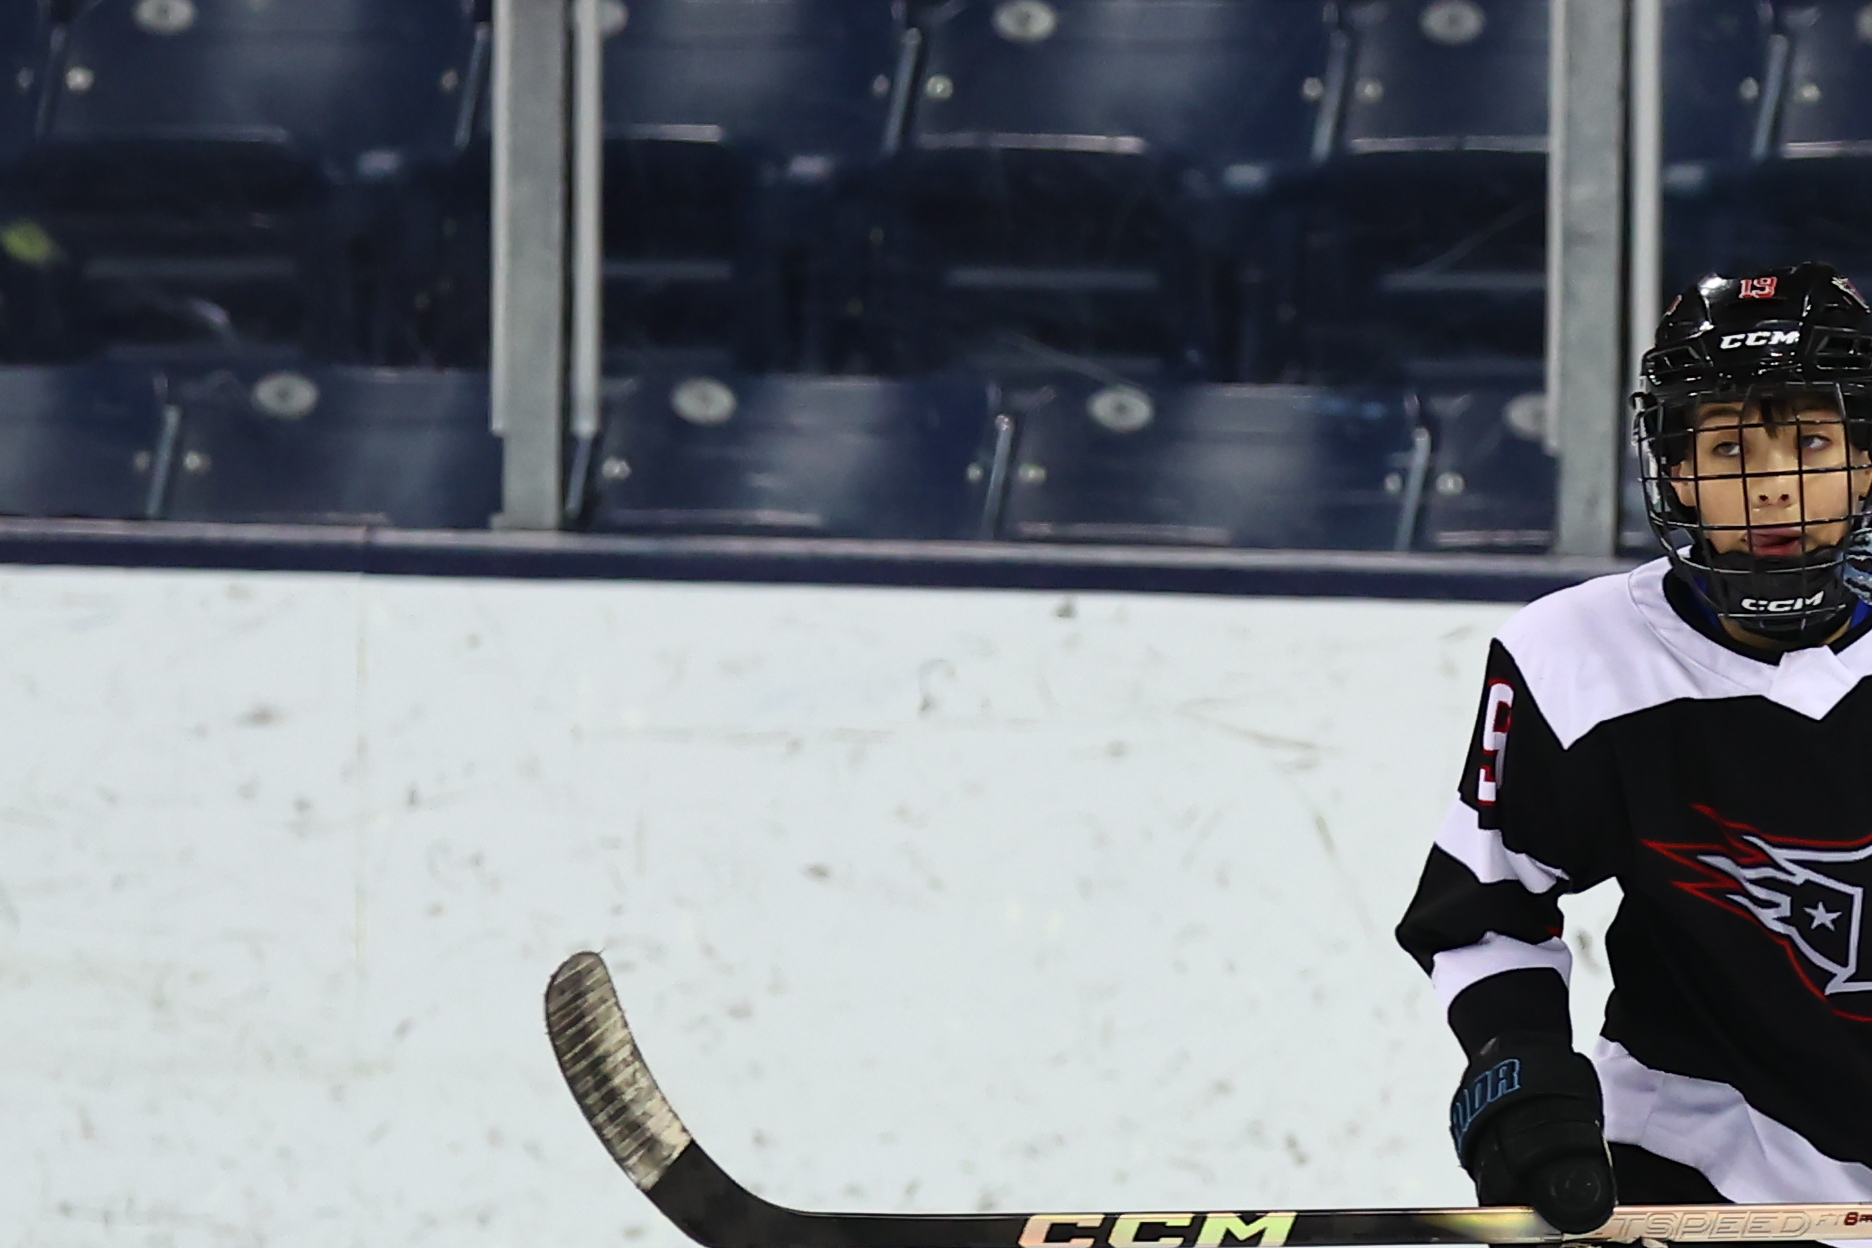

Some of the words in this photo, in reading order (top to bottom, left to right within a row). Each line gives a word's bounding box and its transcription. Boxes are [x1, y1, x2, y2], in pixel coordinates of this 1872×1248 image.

[1738, 276, 1778, 299] 19
[1719, 330, 1801, 350] CCM
[1741, 590, 1825, 612] CCM
[1612, 1209, 1812, 1241] TSPEED
